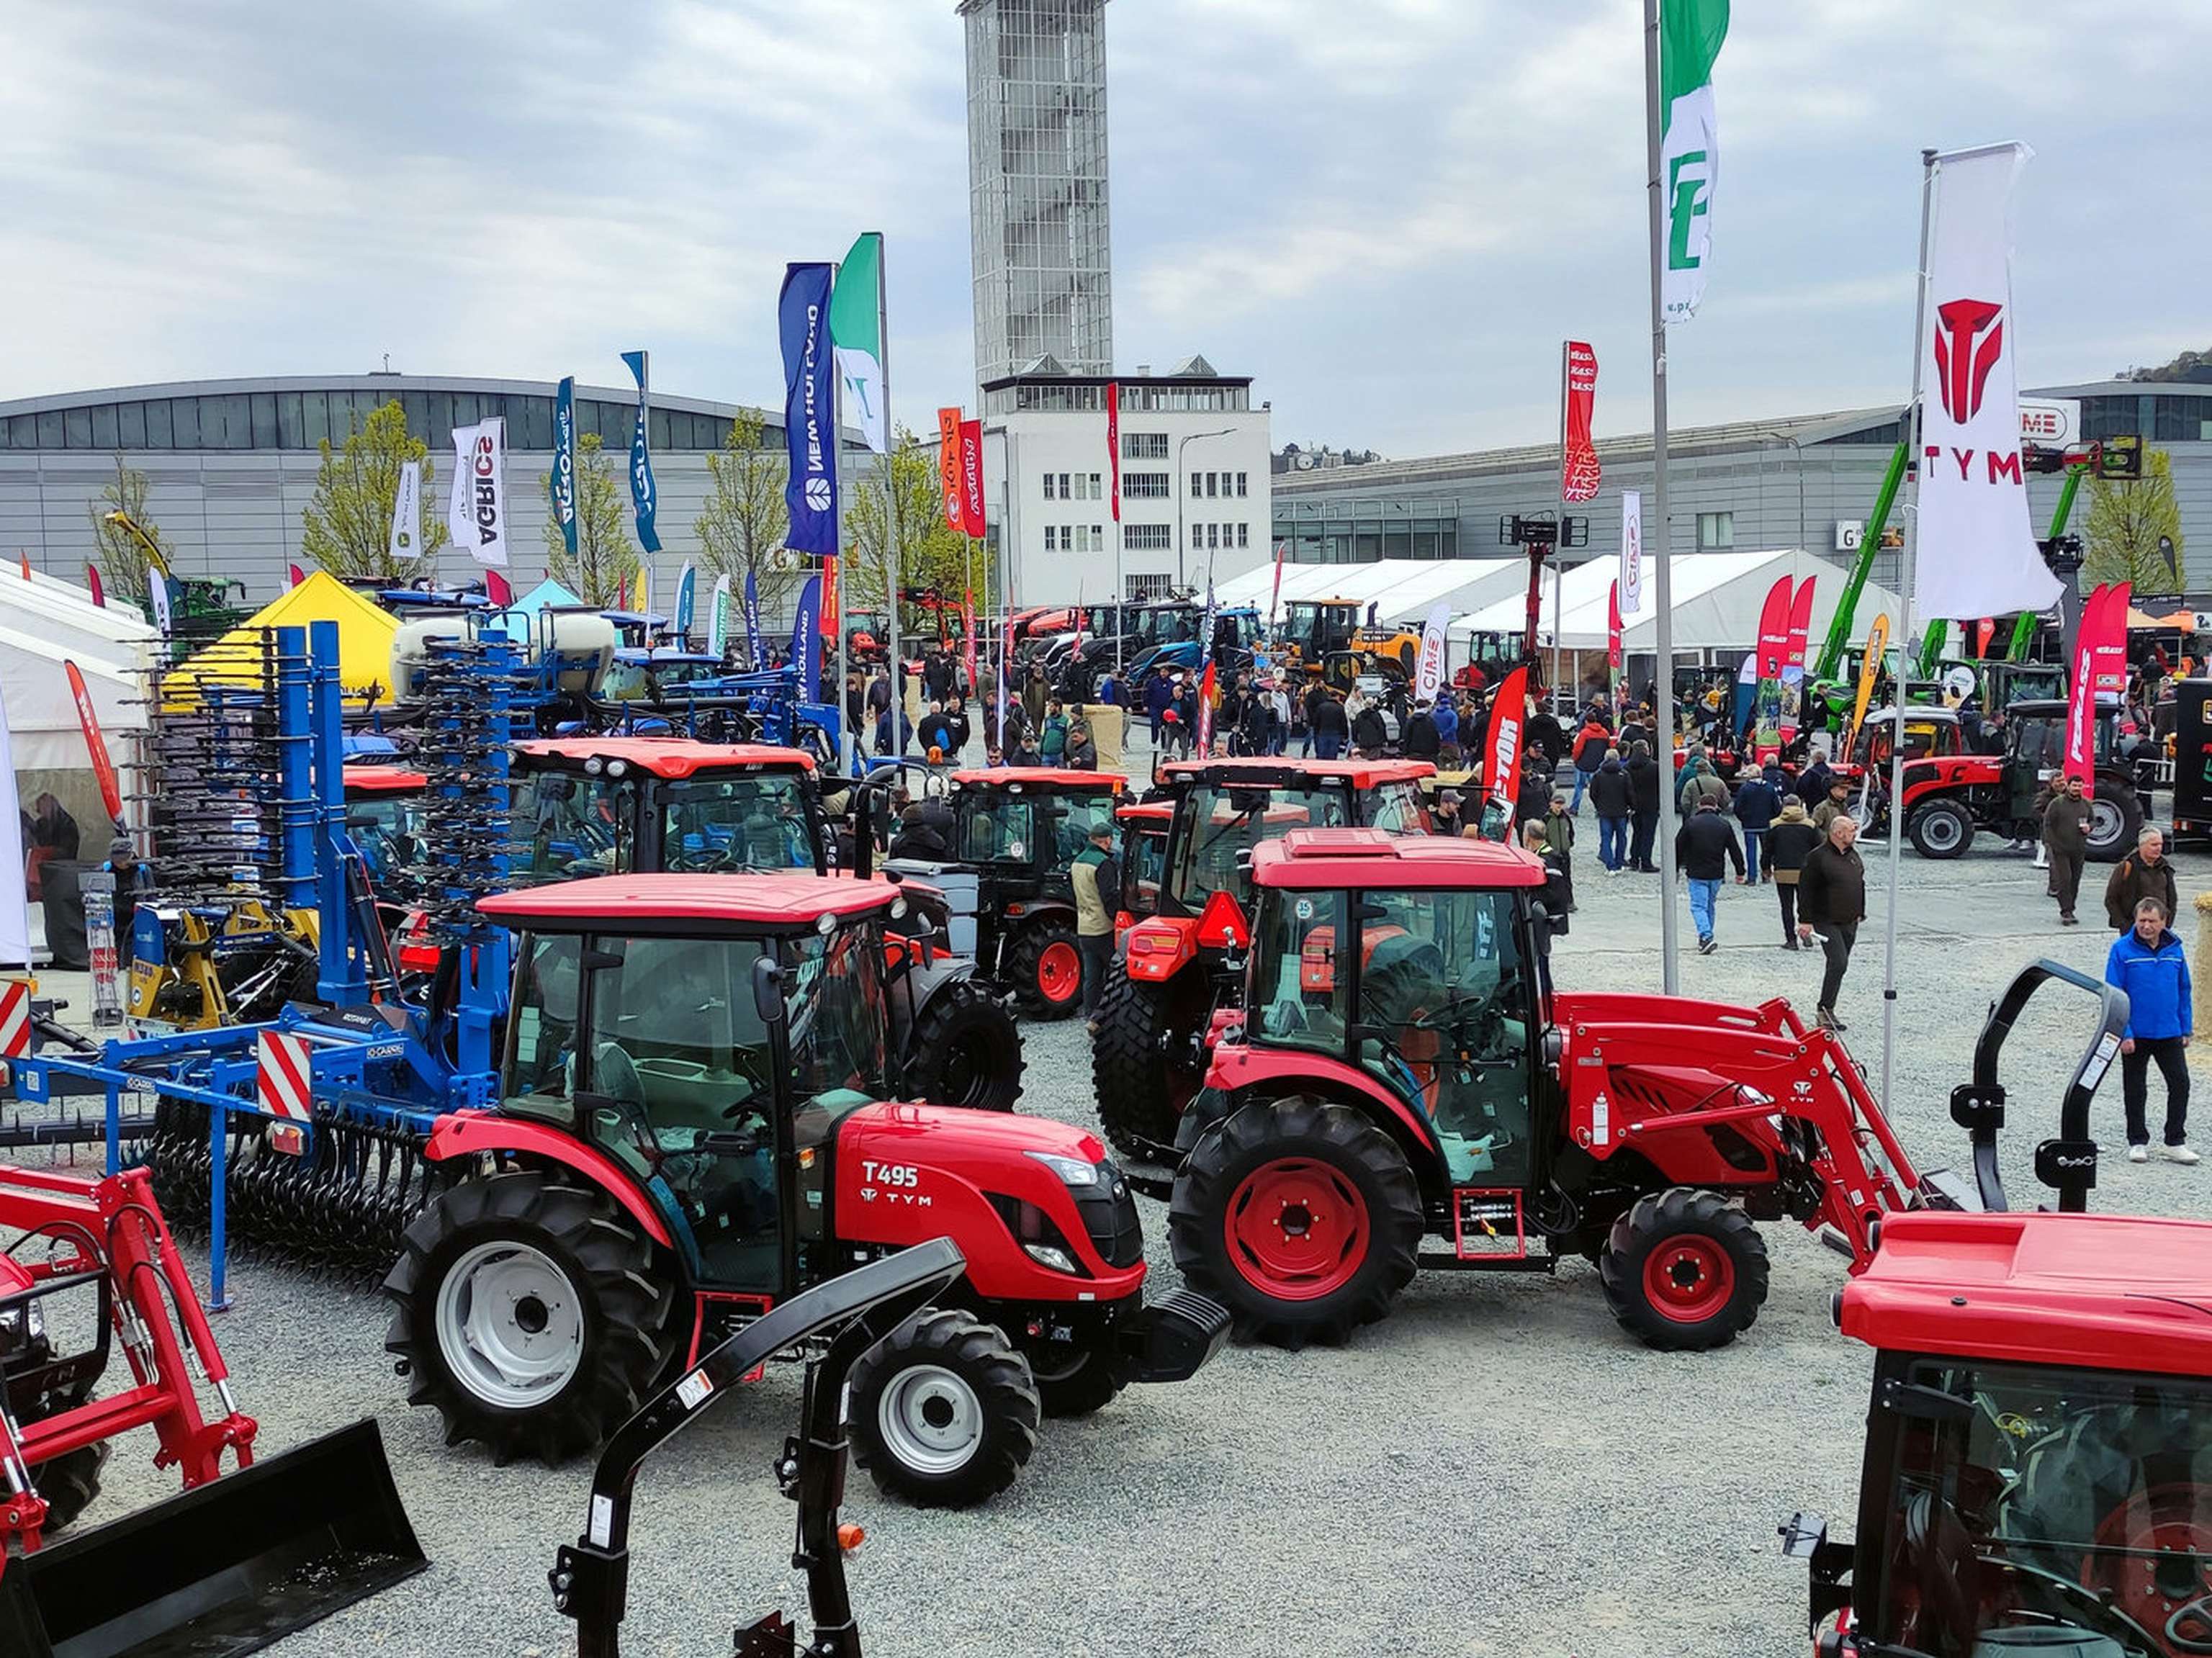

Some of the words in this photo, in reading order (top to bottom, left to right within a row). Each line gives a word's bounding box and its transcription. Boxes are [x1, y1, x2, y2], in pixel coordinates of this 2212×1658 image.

[1925, 446, 2023, 485] TYM
[861, 1160, 918, 1188] T495
[886, 1192, 932, 1207] TYM
